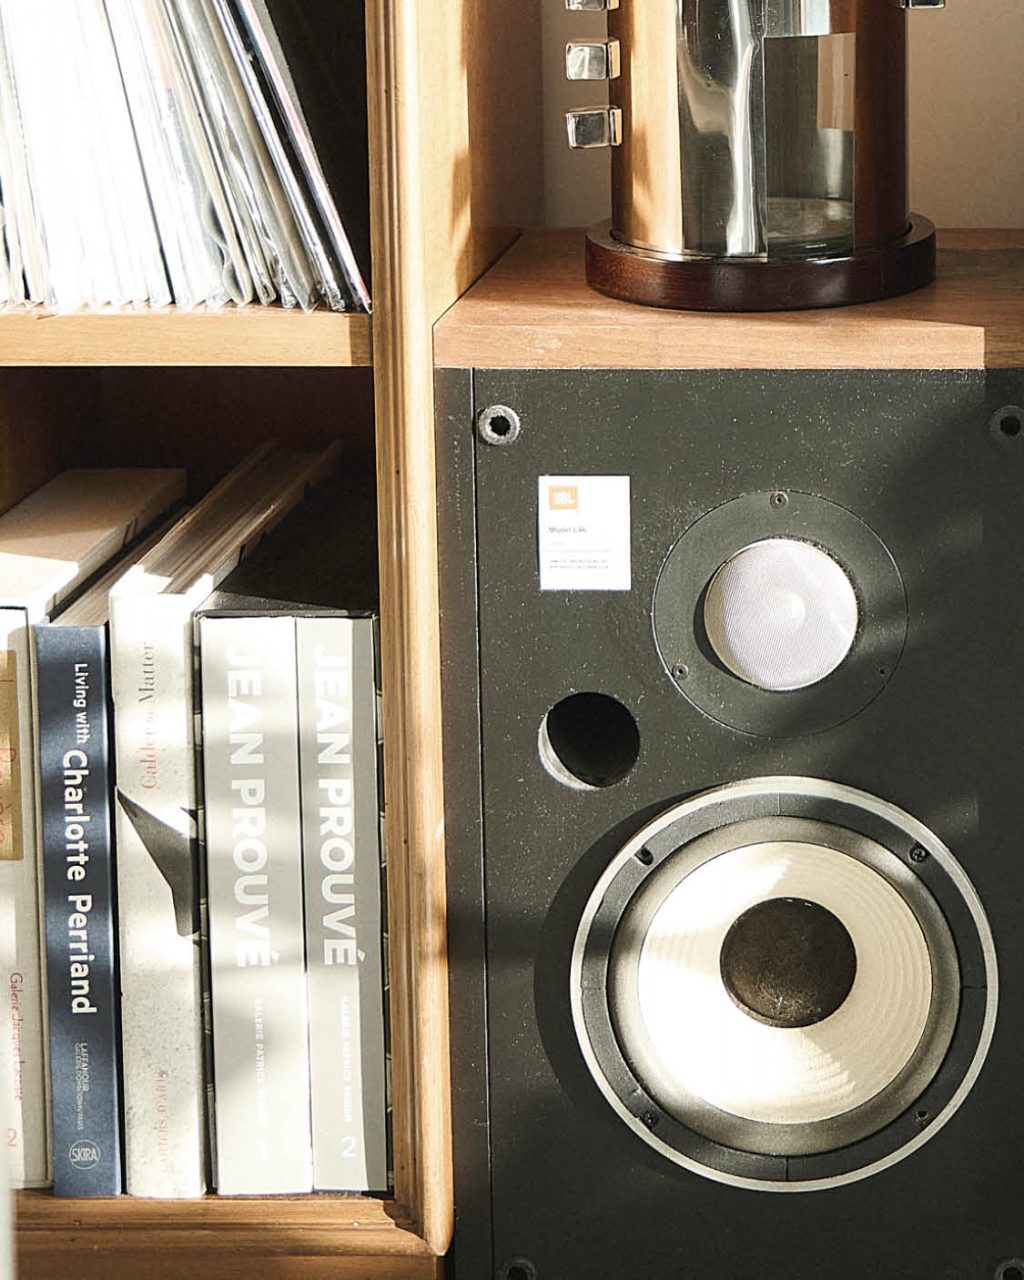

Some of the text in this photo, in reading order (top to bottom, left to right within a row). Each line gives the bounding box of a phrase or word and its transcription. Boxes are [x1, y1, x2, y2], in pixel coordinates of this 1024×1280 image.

[138, 641, 155, 704] Matter
[226, 644, 280, 968] JEAN PROUVÉ
[315, 642, 366, 967] JEAN PROUVÉ
[62, 663, 98, 1015] Living with Charlotte Perriand
[9, 972, 24, 1012] Galerie
[7, 1128, 18, 1148] 2
[71, 1147, 99, 1163] SKIRA
[341, 1136, 357, 1159] 2
